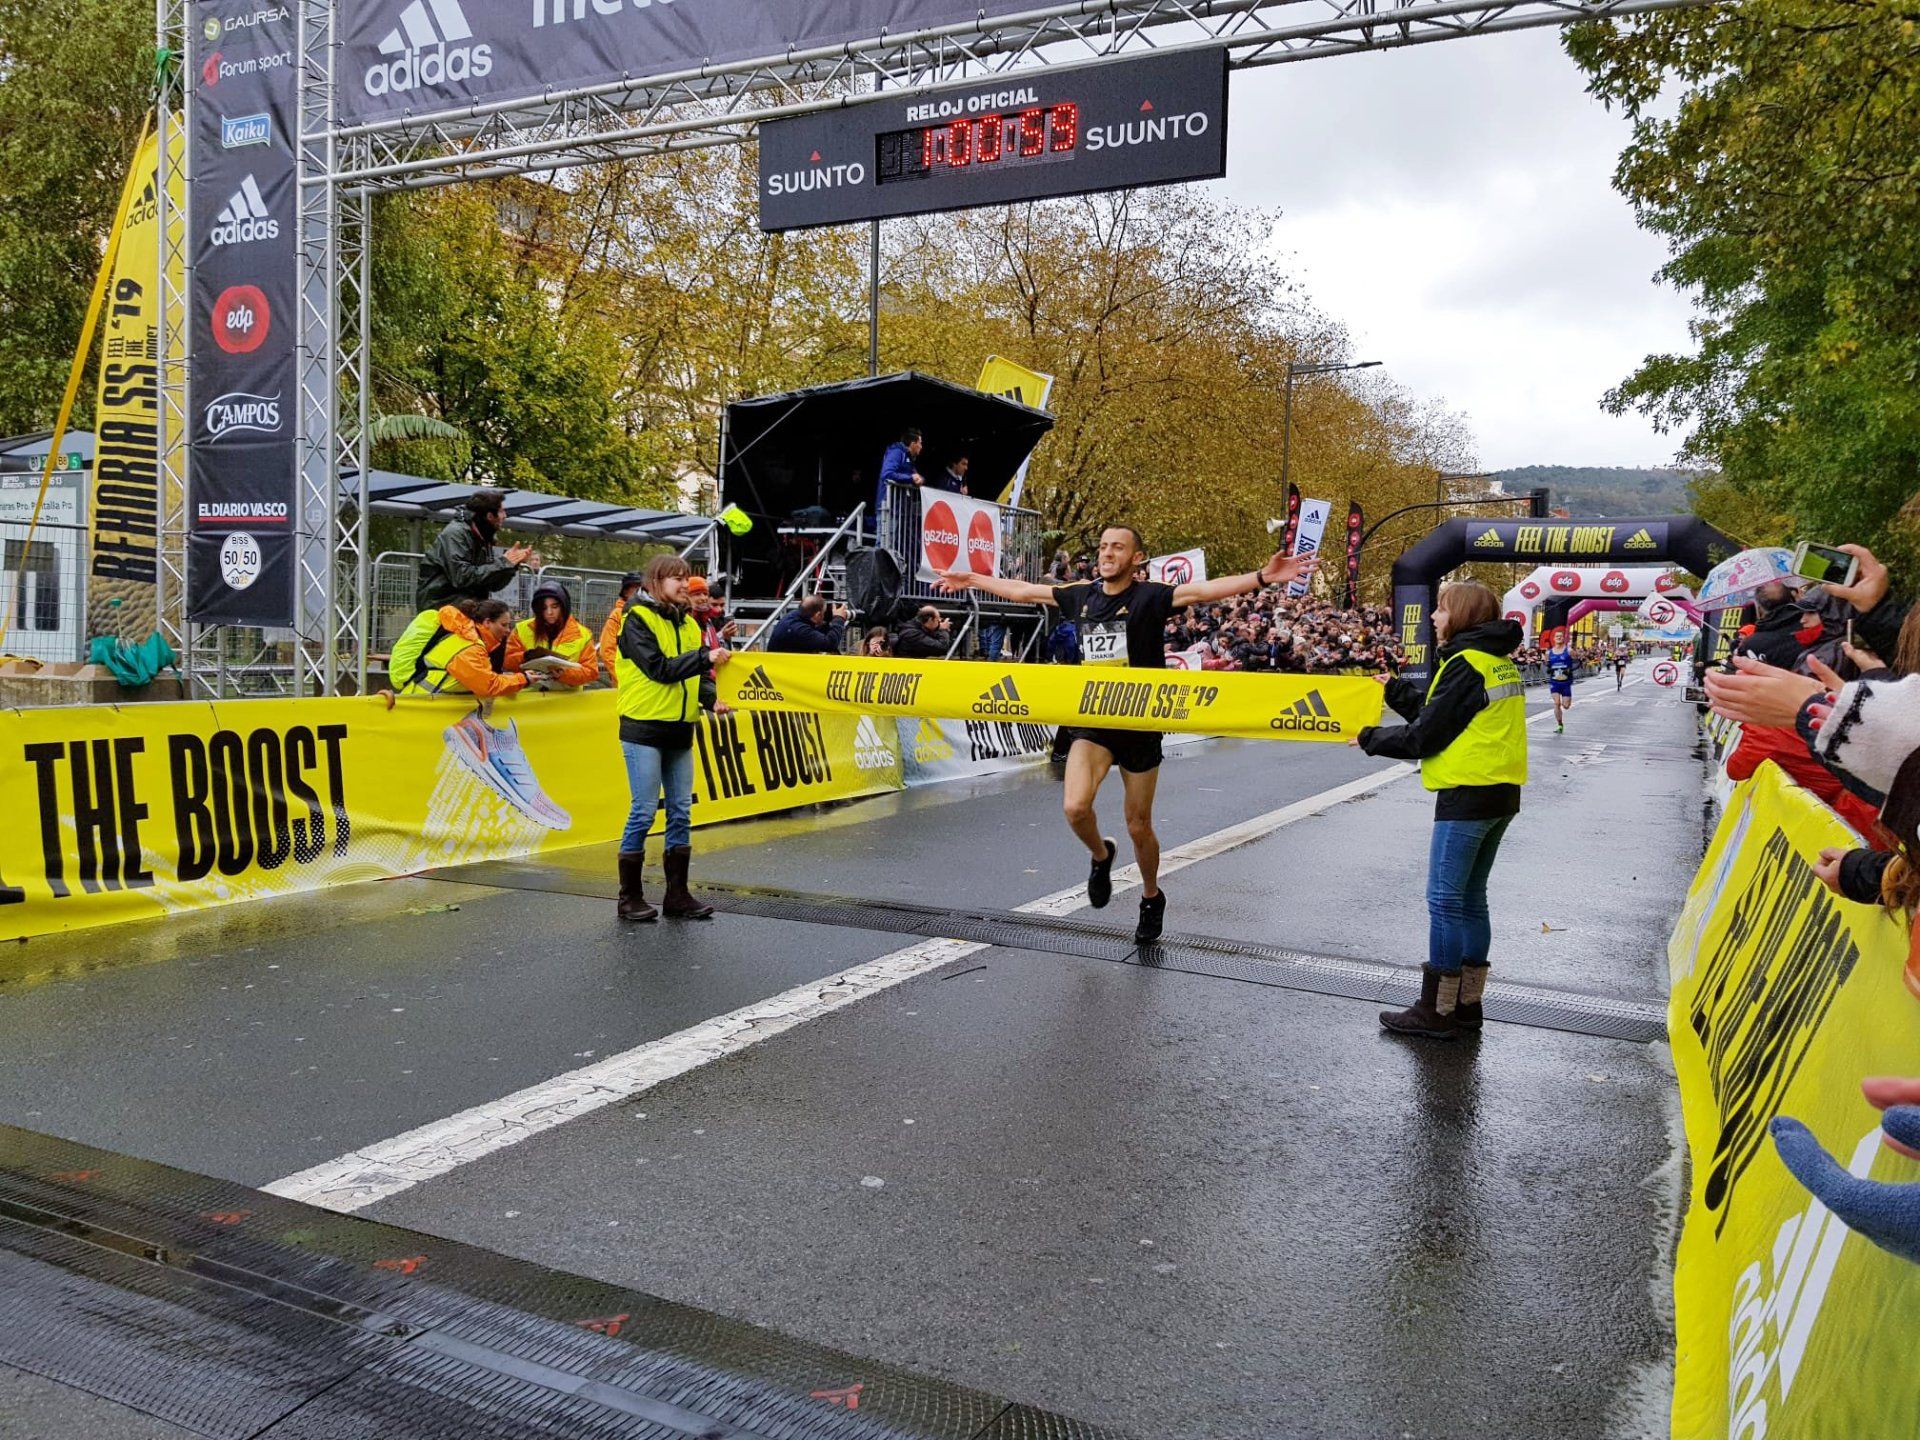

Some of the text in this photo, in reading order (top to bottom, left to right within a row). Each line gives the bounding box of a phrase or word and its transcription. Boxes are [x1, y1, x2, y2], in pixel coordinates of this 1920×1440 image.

[225, 6, 289, 31] GAURSA
[259, 51, 291, 71] sport
[365, 42, 492, 96] adidas
[906, 88, 1038, 122] RELOJ OFICIAL
[226, 121, 265, 143] Kaiku
[1086, 112, 1208, 151] SUUNTO
[768, 163, 865, 195] SUUNTO
[210, 217, 279, 246] adidas
[226, 305, 254, 333] edp
[107, 336, 124, 358] FEEL
[125, 340, 143, 358] THE
[103, 363, 158, 409] SS
[206, 402, 279, 434] CAMPOS
[93, 421, 158, 584] BEHOBIA
[199, 503, 212, 517] EL
[212, 503, 249, 517] DIARIO
[250, 503, 287, 517] VASCO
[924, 529, 959, 546] gaztea
[1514, 526, 1615, 553] FEEL THE BOOST
[1623, 541, 1657, 549] adidas
[1403, 604, 1421, 625] FEEL
[1087, 635, 1117, 652] 127
[1402, 624, 1417, 645] THE
[737, 688, 784, 701] adidas
[827, 670, 923, 706] FEEL THE BOOST
[1179, 684, 1191, 696] FEEL
[972, 698, 1029, 716] adidas
[1078, 680, 1179, 719] BEHOBIA SS
[1176, 696, 1186, 708] THE
[1172, 708, 1190, 720] BOOST
[1270, 714, 1341, 733] adidas
[965, 719, 999, 762] FEEL
[995, 721, 1022, 757] THE
[695, 710, 833, 801] THE BOOST
[854, 749, 895, 769] adidas
[24, 724, 351, 899] THE BOOST
